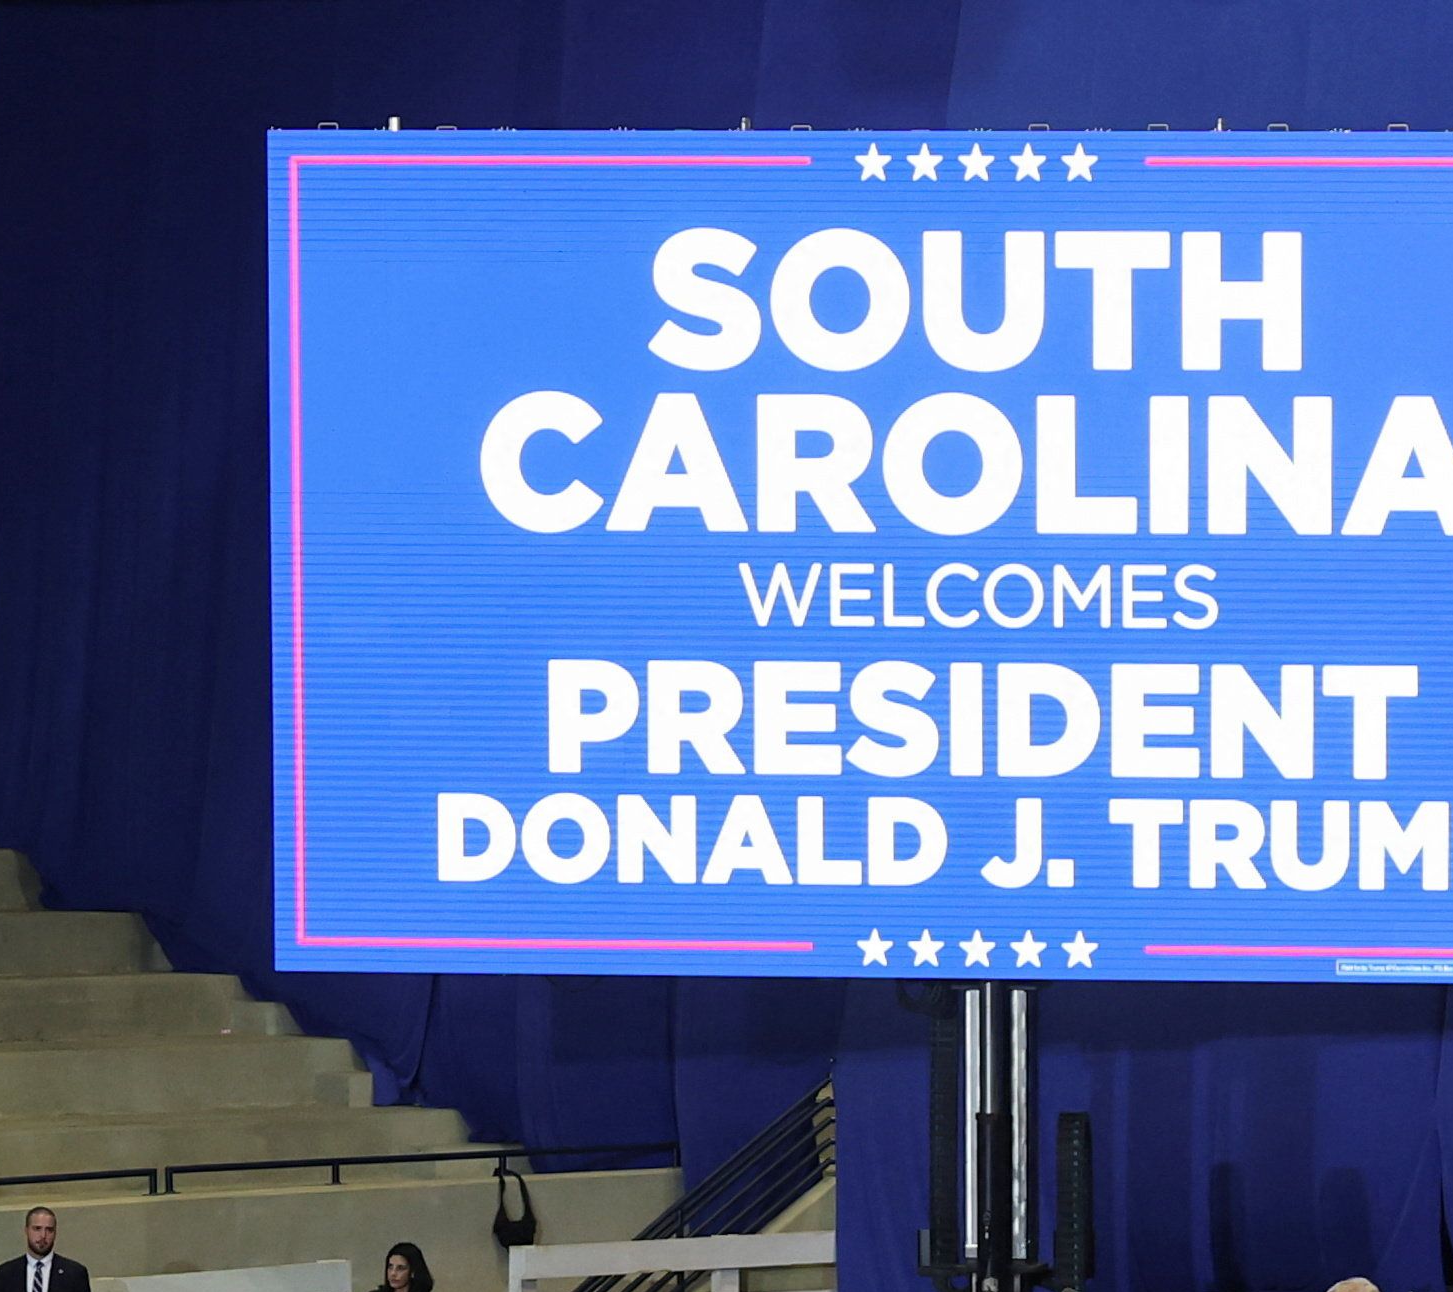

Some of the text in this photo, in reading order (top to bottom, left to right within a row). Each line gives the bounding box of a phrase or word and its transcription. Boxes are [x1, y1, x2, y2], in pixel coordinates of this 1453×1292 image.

[647, 226, 1302, 372] SOUTH
[737, 562, 1220, 630] WELCOMES
[548, 658, 1419, 780] PRESIDENT
[436, 792, 947, 887] DONALD
[980, 797, 1075, 889] J.
